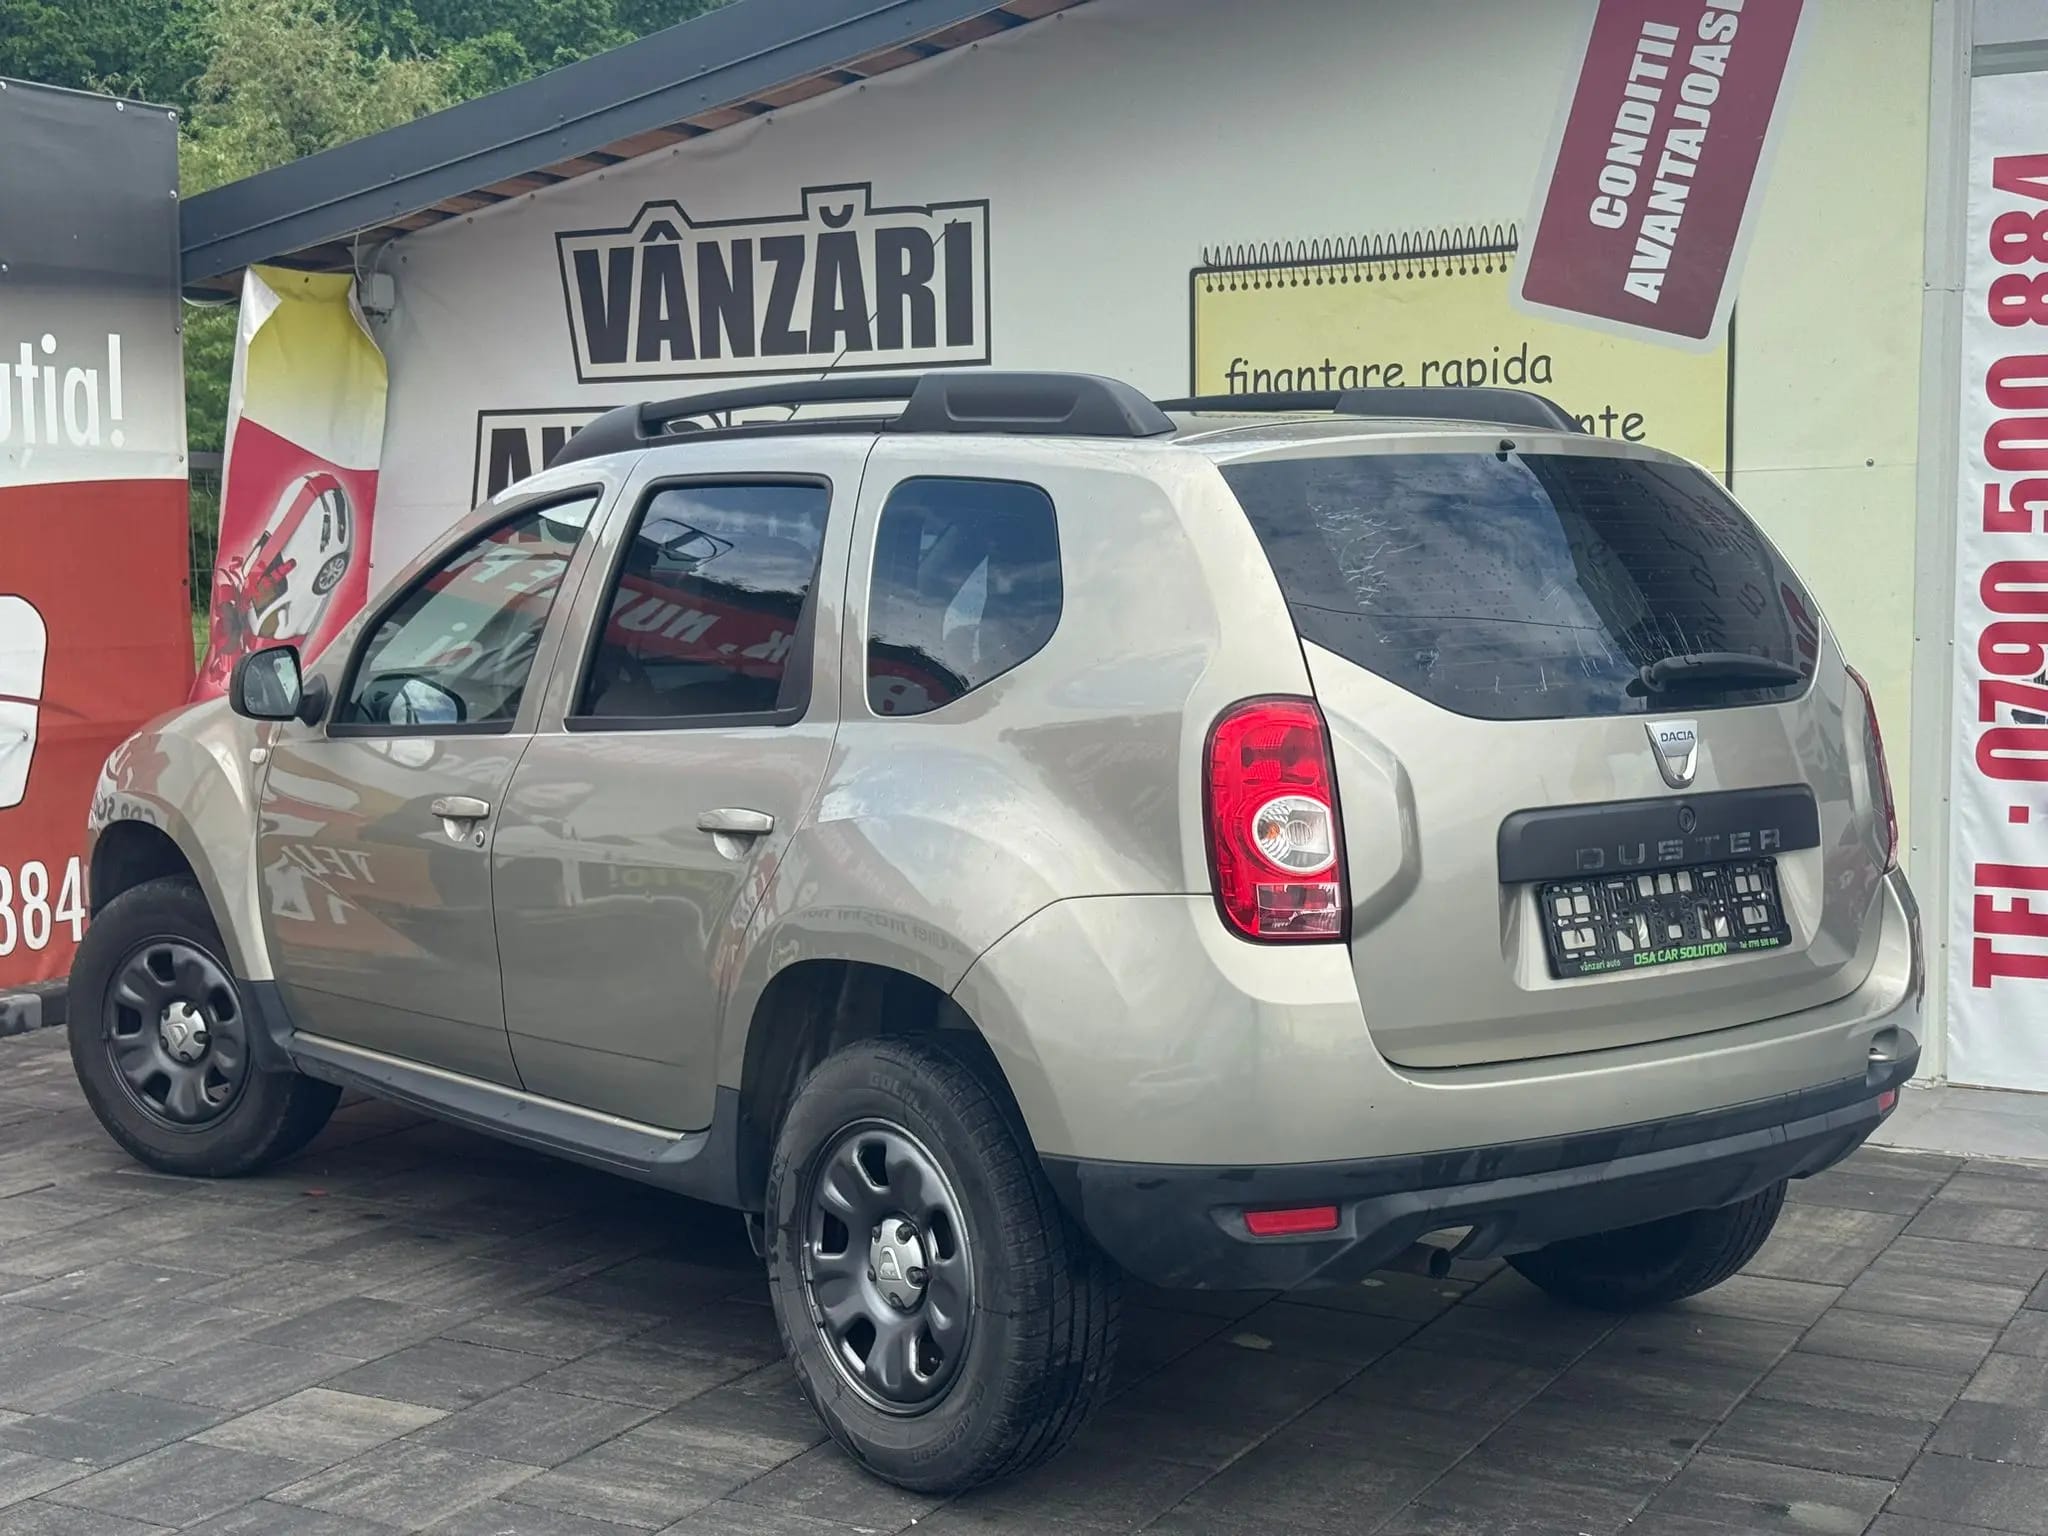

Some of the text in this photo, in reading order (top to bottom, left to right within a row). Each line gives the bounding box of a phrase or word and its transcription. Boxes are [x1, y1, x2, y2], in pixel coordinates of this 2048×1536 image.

[1589, 20, 1681, 230] CONDITII
[573, 203, 973, 364] VÂNZĂRI
[1224, 341, 1553, 396] finantare rapida
[1981, 354, 2048, 534] 500
[1660, 730, 1695, 743] DACIA
[1575, 827, 1781, 871] DUSTER
[1633, 941, 1728, 967] DSA CAR SOLUTION
